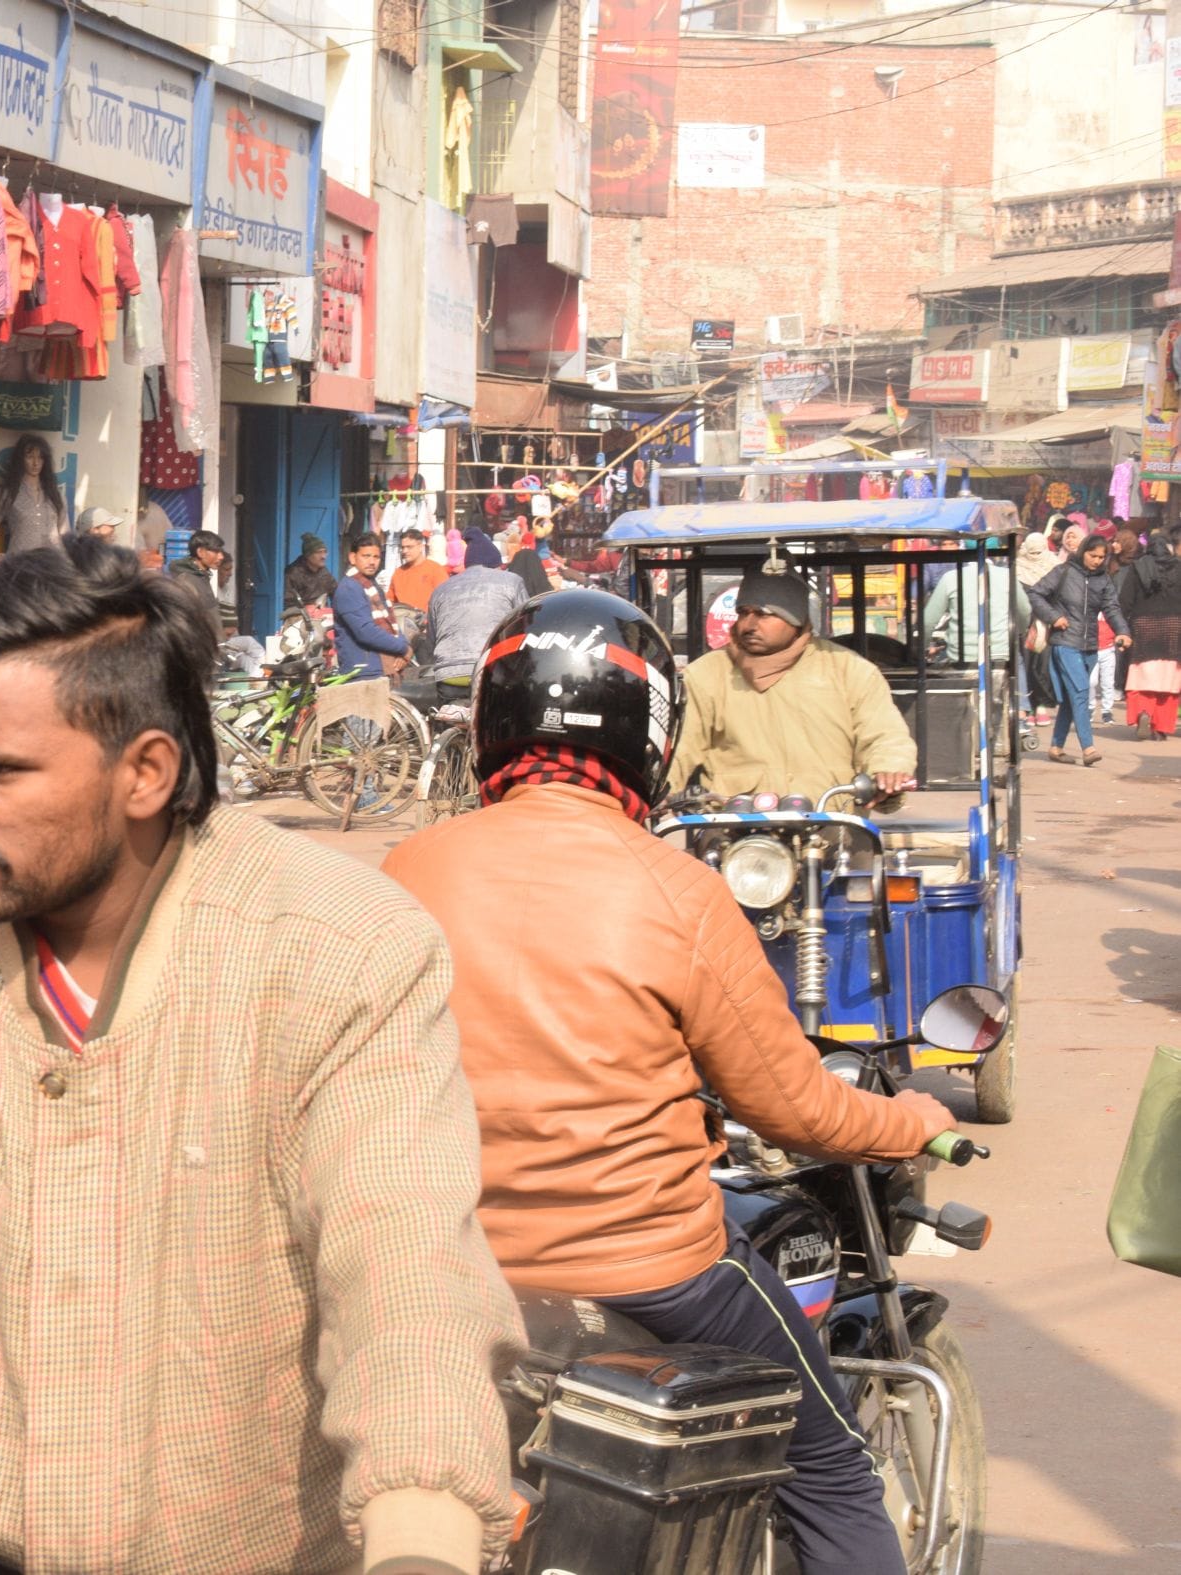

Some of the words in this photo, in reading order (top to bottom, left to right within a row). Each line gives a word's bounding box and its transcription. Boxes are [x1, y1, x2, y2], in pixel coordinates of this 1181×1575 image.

[87, 61, 124, 151] रौनक
[226, 107, 291, 201] सिंह
[923, 359, 972, 378] USHA
[519, 624, 608, 660] NINJA
[779, 1240, 833, 1266] HONDA
[789, 1231, 824, 1249] HERO
